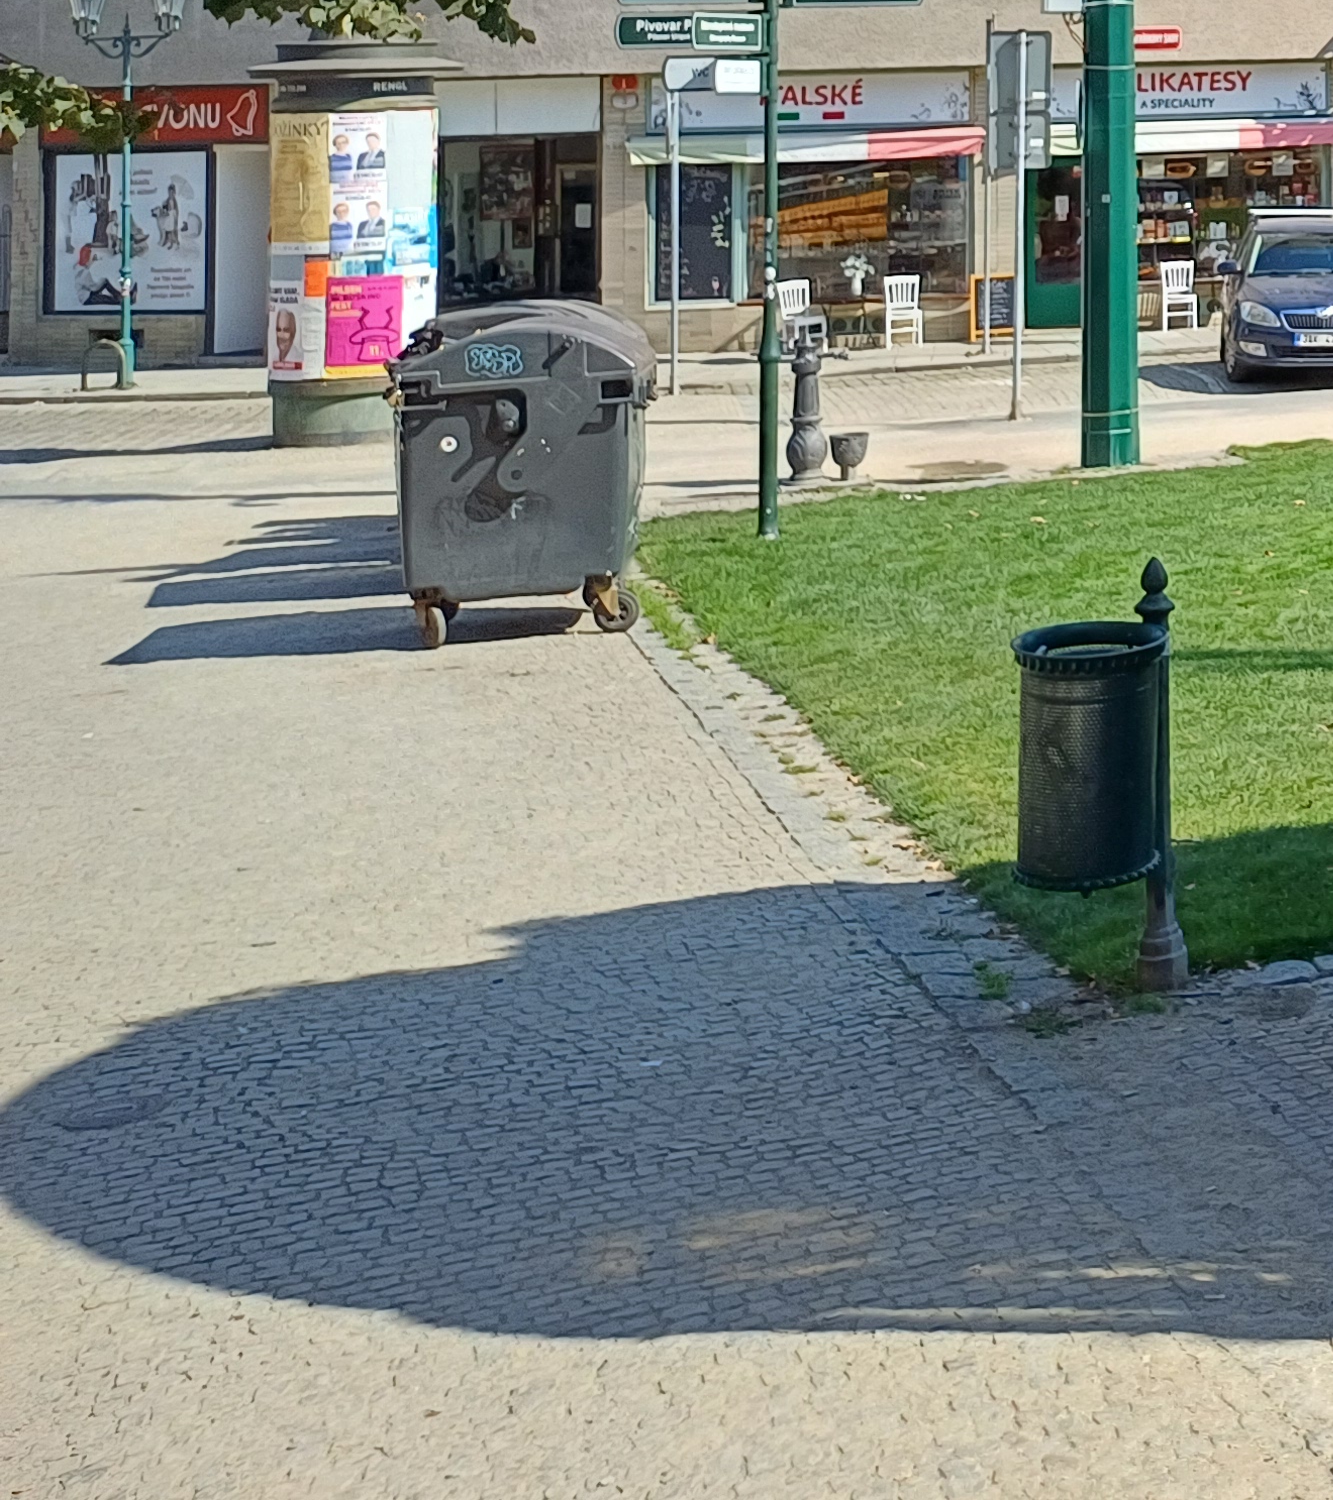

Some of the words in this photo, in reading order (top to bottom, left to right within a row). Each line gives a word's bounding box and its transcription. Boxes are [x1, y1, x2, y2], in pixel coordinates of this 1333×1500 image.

[635, 19, 681, 32] Pivovar
[1140, 101, 1148, 109] A
[1151, 97, 1216, 109] SPECIALITY
